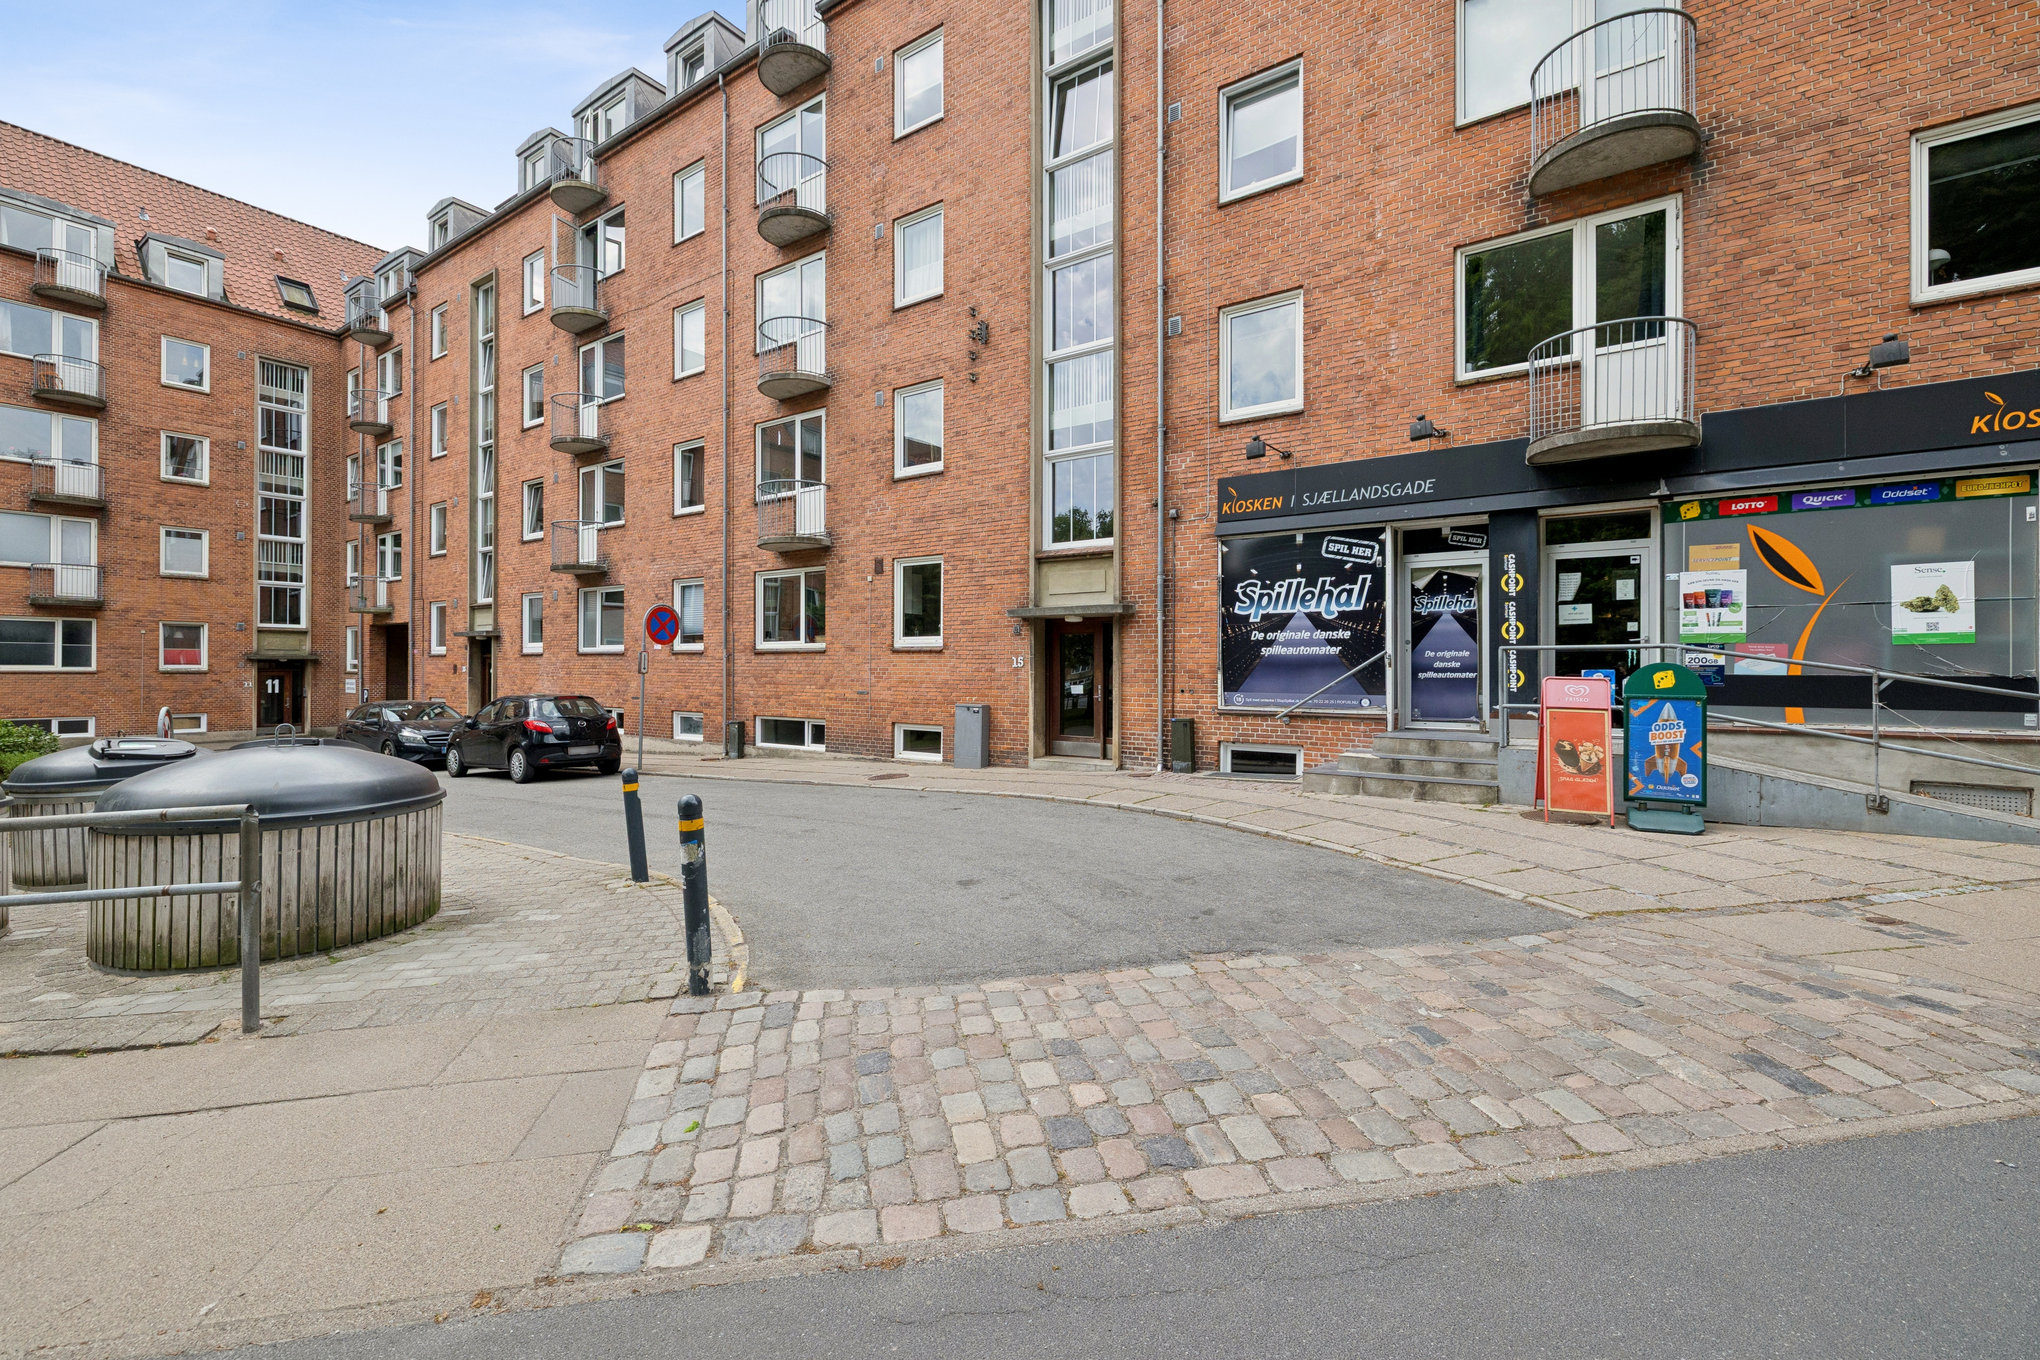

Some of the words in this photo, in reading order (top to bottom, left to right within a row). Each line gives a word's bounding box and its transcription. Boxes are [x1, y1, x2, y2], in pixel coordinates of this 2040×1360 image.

[1882, 486, 1930, 499] Oddset
[1960, 481, 2025, 493] EUROJACKPOT
[1222, 492, 1283, 515] KIOSKEN
[1302, 479, 1436, 506] SJÆLLANDSGADE
[1802, 494, 1844, 506] QUICK
[1731, 501, 1765, 510] LOTTO
[1452, 534, 1467, 542] SPIL
[1468, 536, 1483, 544] HER
[1328, 543, 1350, 554] SPIL
[1350, 544, 1373, 557] HER
[1508, 553, 1516, 597] CASHPOINT
[1234, 574, 1372, 622] Spillehal
[1508, 601, 1517, 645] CASHPOINT
[1250, 630, 1264, 641] De
[1266, 629, 1311, 642] originale
[1312, 628, 1352, 640] danske
[1260, 645, 1342, 657] spilleautomater
[1436, 650, 1470, 659] originale
[1012, 656, 1024, 668] 15
[1418, 671, 1478, 680] spilleautomater
[1509, 649, 1518, 693] CASHPOINT
[265, 679, 280, 694] 11
[1654, 721, 1682, 732] ODDS
[1650, 730, 1685, 741] BOOST
